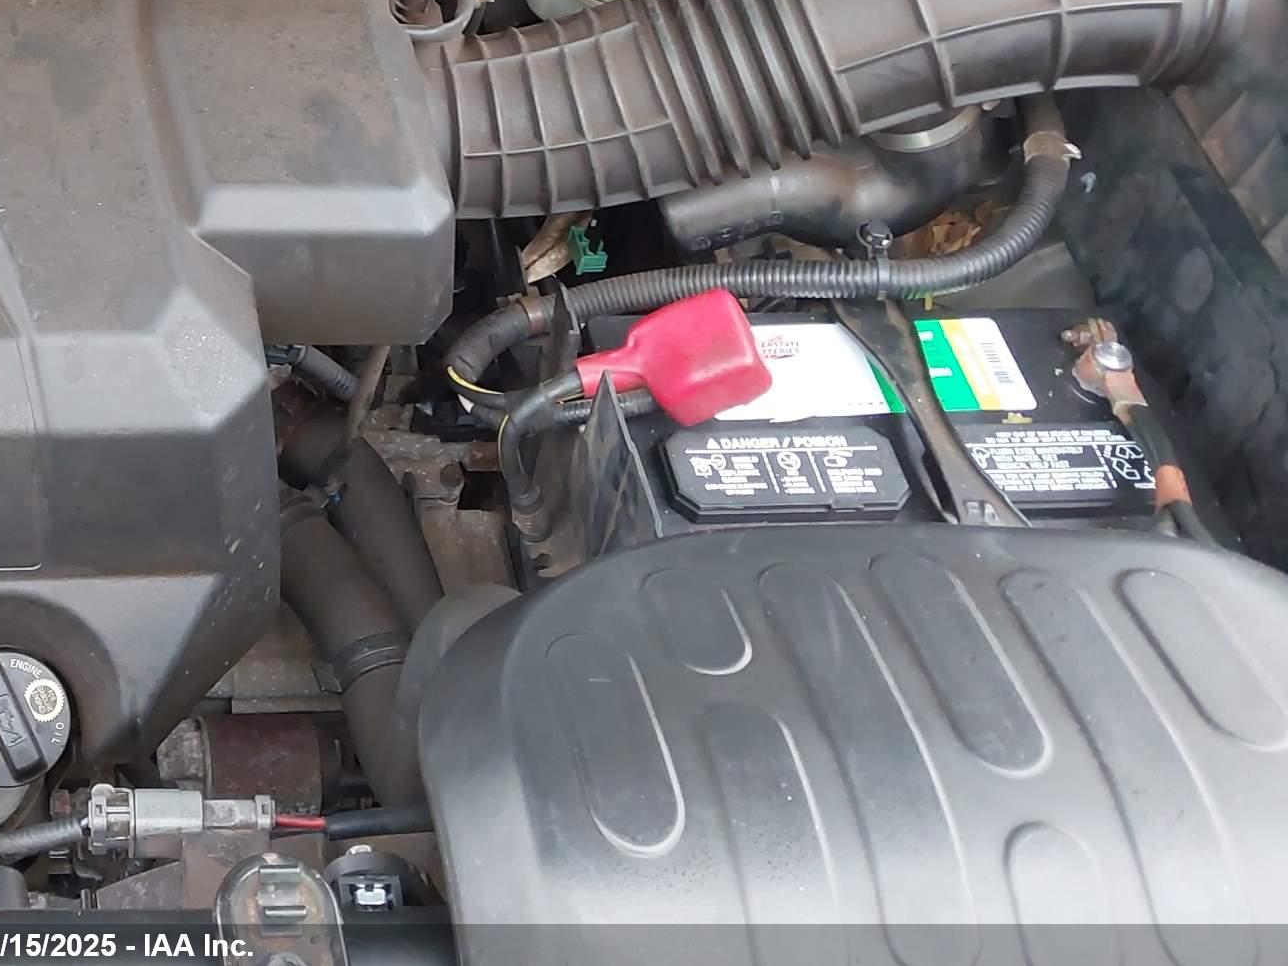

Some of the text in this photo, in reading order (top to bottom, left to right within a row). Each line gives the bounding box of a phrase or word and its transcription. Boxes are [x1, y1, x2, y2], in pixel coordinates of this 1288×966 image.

[719, 437, 781, 450] DANGER
[792, 435, 848, 448] POISON
[10, 658, 43, 679] ENGINE
[51, 722, 65, 744] OIL
